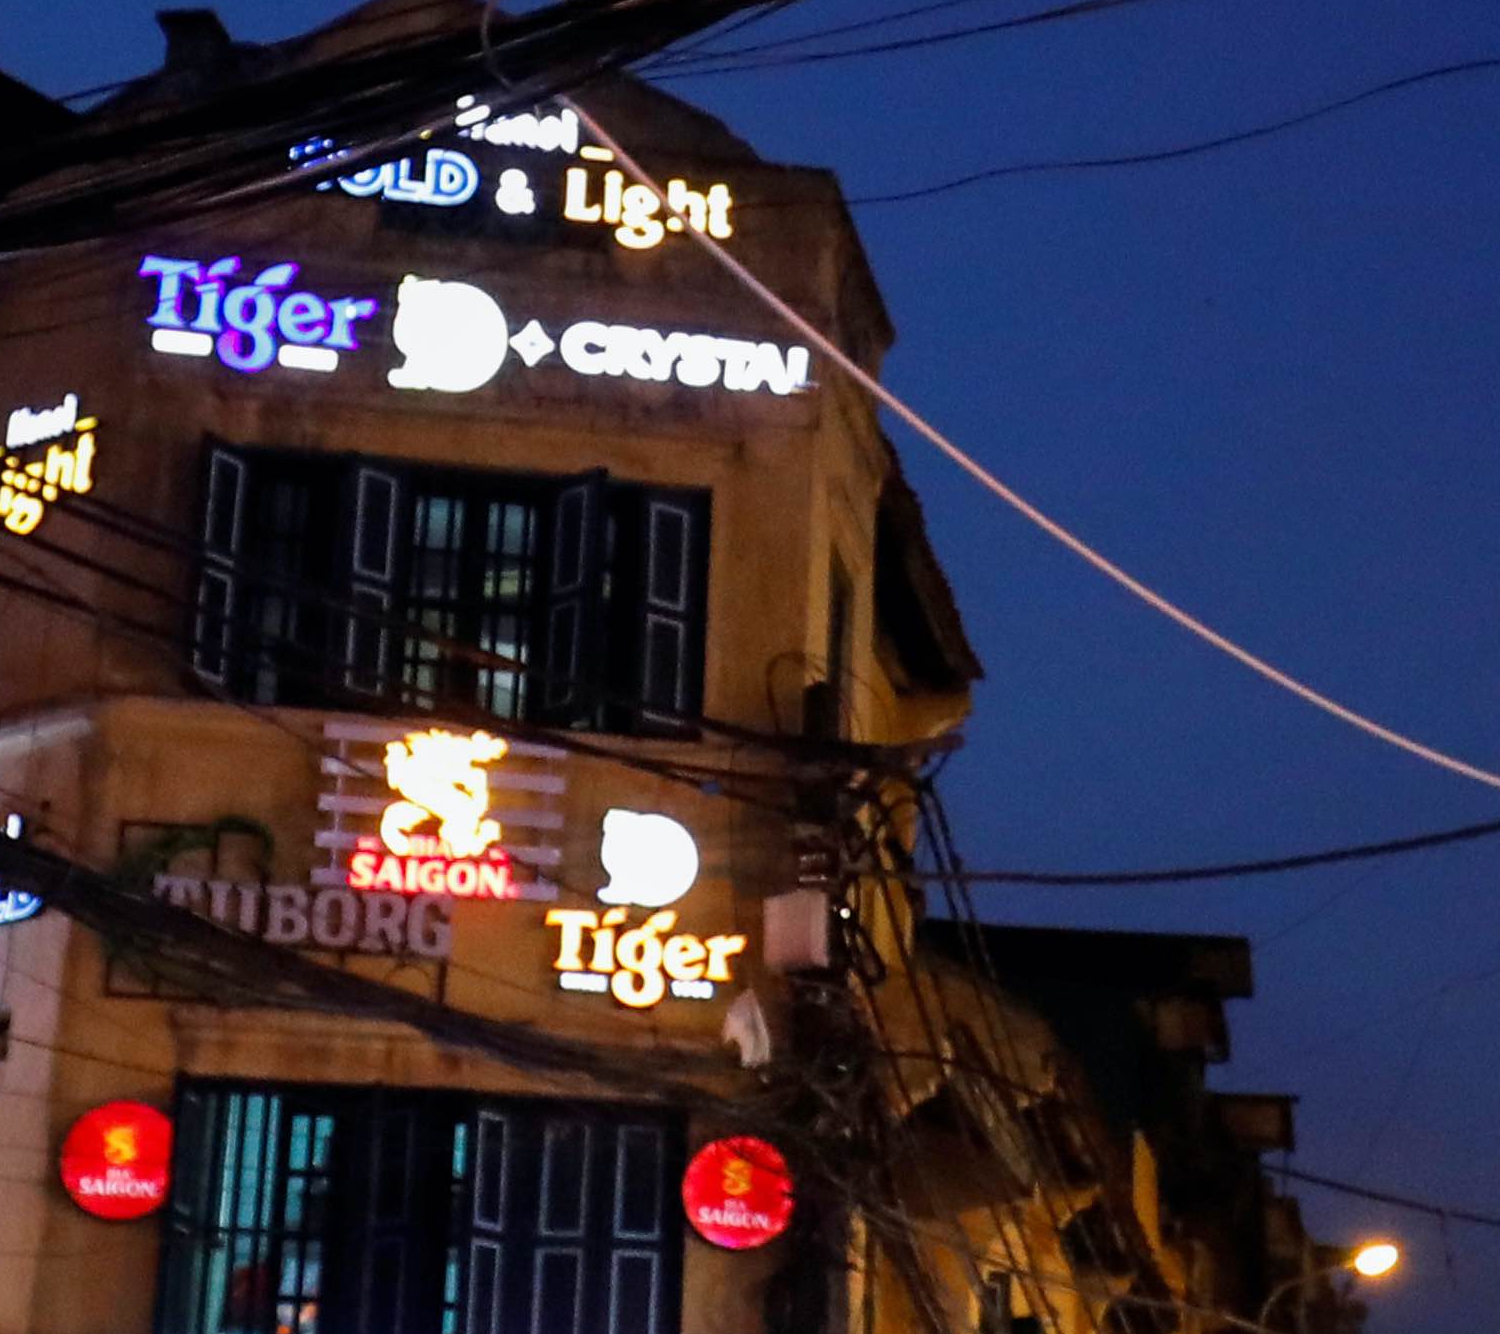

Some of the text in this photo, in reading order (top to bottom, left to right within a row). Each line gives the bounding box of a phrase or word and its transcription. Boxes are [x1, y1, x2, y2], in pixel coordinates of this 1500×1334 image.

[495, 168, 536, 216] &
[565, 167, 733, 250] Light
[140, 256, 377, 372] Tiger
[347, 851, 512, 899] SAIGON
[545, 907, 749, 1008] Tiger
[78, 1176, 160, 1197] SAIGON
[697, 1205, 771, 1230] SAIGON
